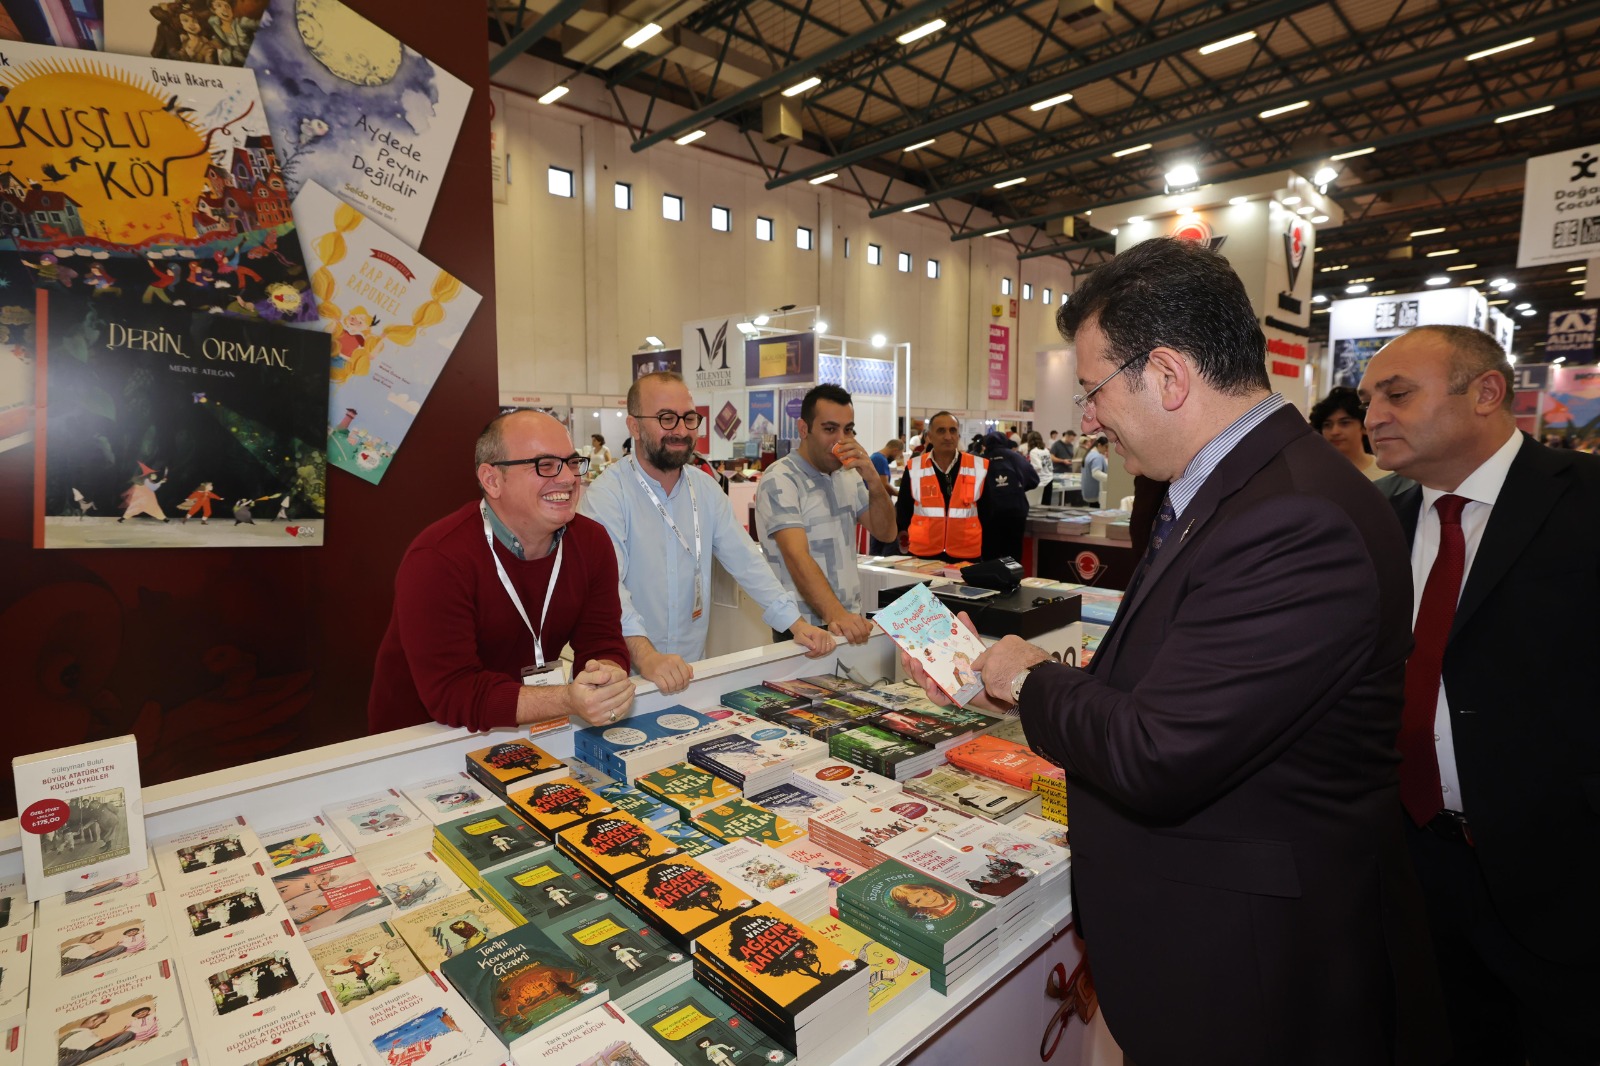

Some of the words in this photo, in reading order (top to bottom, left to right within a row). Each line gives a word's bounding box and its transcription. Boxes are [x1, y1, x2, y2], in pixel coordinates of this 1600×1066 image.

[150, 66, 181, 87] Öykü
[185, 73, 224, 89] Akarca
[4, 106, 152, 152] KUŞLU
[355, 115, 421, 162] Aydede
[95, 157, 172, 200] KÖY
[352, 156, 417, 198] Değildir
[377, 148, 428, 184] Peynir
[359, 261, 383, 284] RAP
[383, 275, 407, 299] RAP
[347, 274, 401, 316] RAPUNZEL
[106, 322, 190, 359] DERİN
[202, 337, 293, 370] ORMAN
[169, 364, 197, 374] MERVE
[202, 368, 235, 378] ATILGAN
[696, 371, 731, 380] MİLENYUM
[696, 379, 731, 388] YAYINCILIK
[42, 774, 66, 785] BÜYÜK
[69, 765, 115, 779] ATATÜRK'TEN
[52, 762, 85, 774] Süleyman
[87, 758, 104, 766] Bulut
[50, 781, 75, 790] KÜÇÜK
[77, 773, 109, 784] ÖYKÜLER
[590, 824, 633, 845] AĞACIN
[596, 820, 616, 829] TINA
[723, 813, 758, 829] TEPE
[724, 813, 774, 837] TAKLAK
[652, 869, 699, 898] AĞACIN
[658, 866, 679, 877] TINA
[654, 873, 713, 909] HAFIZASI
[741, 918, 764, 933] TINA
[745, 918, 778, 940] VALLÈS
[738, 922, 789, 959] AĞACIN
[744, 926, 805, 975] HAFIZASI
[477, 943, 527, 971] Konağın
[493, 952, 530, 976] Gizemi
[369, 1007, 397, 1021] BALİNA
[398, 994, 419, 1007] NASIL
[370, 1012, 399, 1026] BALİNA
[400, 998, 423, 1012] OLDU?
[371, 1004, 383, 1012] Ted
[384, 992, 410, 1006] Hughes
[226, 1036, 258, 1052] BÜYÜK
[259, 1011, 317, 1037] ATATÜRK'TEN
[238, 1018, 279, 1039] Süleyman
[281, 1010, 301, 1021] Bulut
[238, 1037, 268, 1054] KÜÇÜK
[270, 1019, 311, 1040] ÖYKÜLER
[545, 1035, 561, 1047] Tarık
[561, 1023, 585, 1038] Dursun
[665, 1013, 702, 1039] post-it'leri
[542, 1040, 568, 1058] HOŞÇA
[567, 1033, 582, 1044] KAL
[582, 1020, 606, 1037] KÜÇÜK
